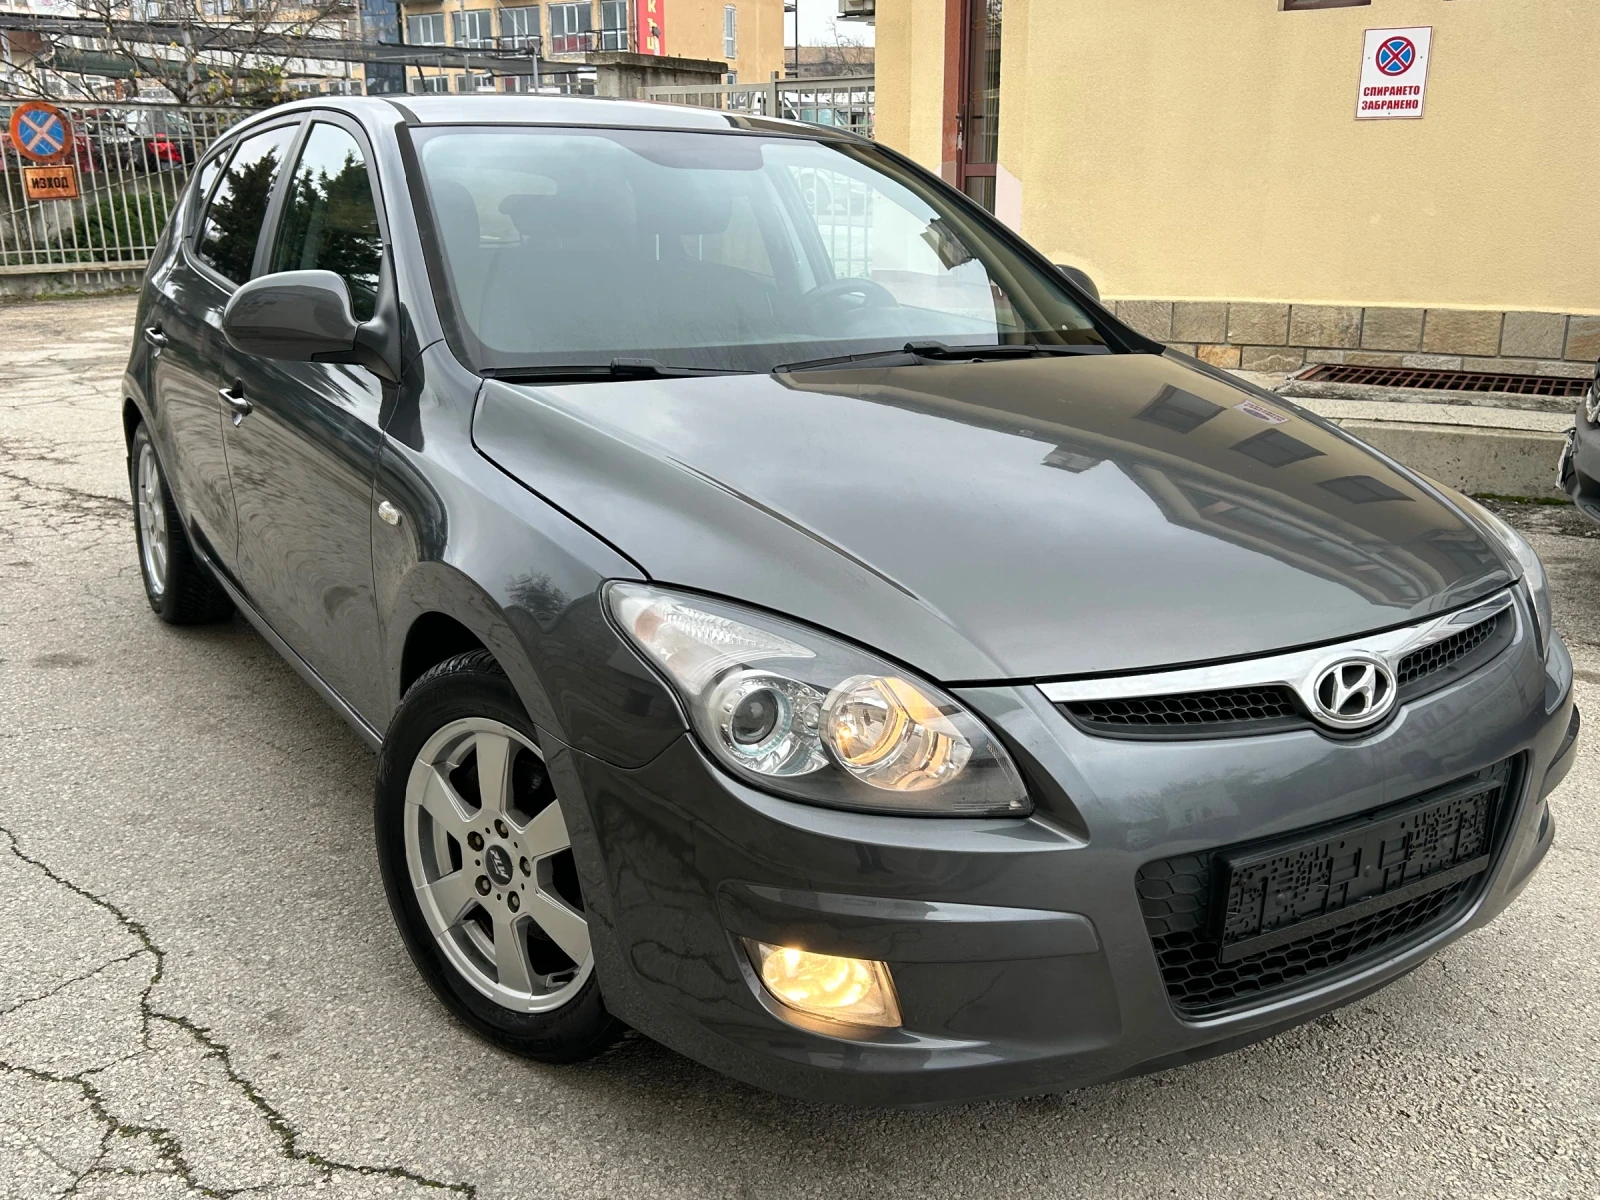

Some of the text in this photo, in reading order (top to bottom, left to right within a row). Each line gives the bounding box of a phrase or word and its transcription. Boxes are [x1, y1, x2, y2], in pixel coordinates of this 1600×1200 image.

[1363, 85, 1420, 97] СПИРАНЕТО
[1361, 99, 1419, 110] ЗАБРАНЕНО
[31, 176, 69, 189] ИЗХОД
